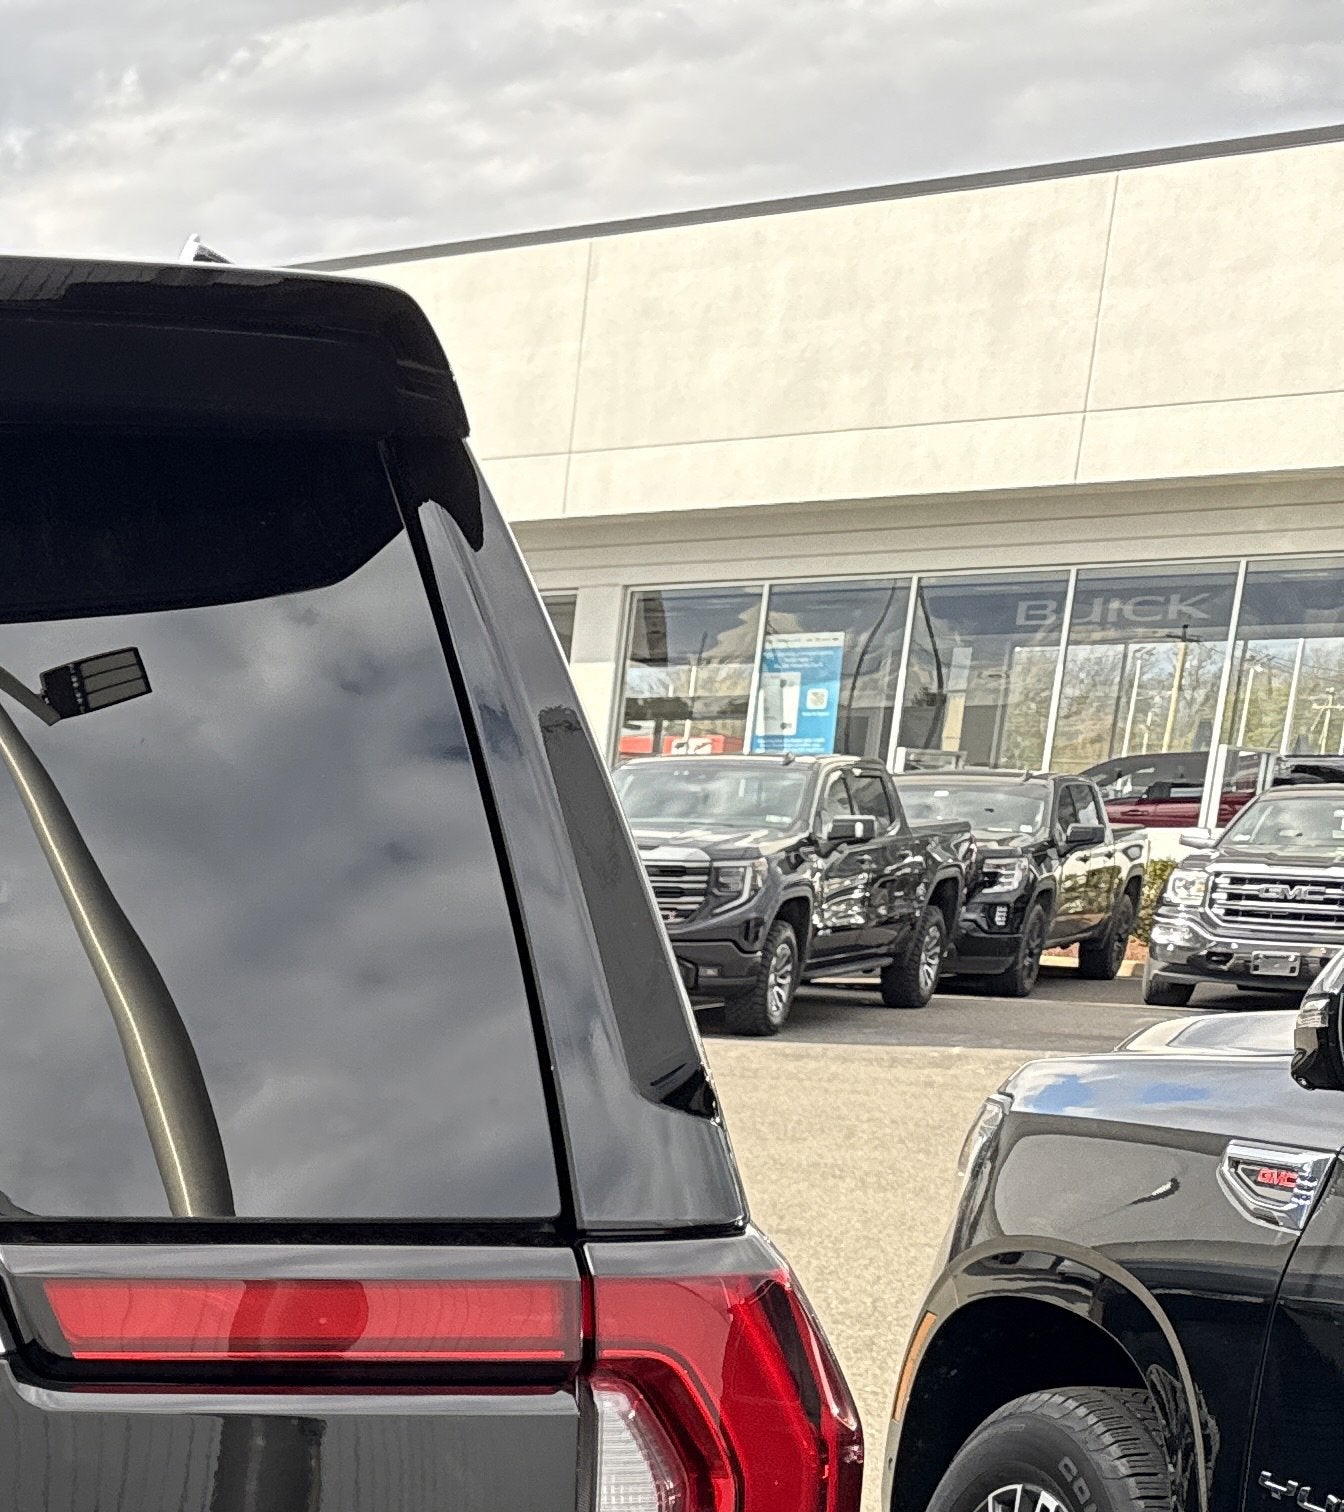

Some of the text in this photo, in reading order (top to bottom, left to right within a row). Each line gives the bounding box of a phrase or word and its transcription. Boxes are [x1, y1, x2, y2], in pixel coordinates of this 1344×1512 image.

[1015, 593, 1211, 625] BUICK
[1259, 884, 1326, 901] GMC
[1257, 1168, 1299, 1188] GMC
